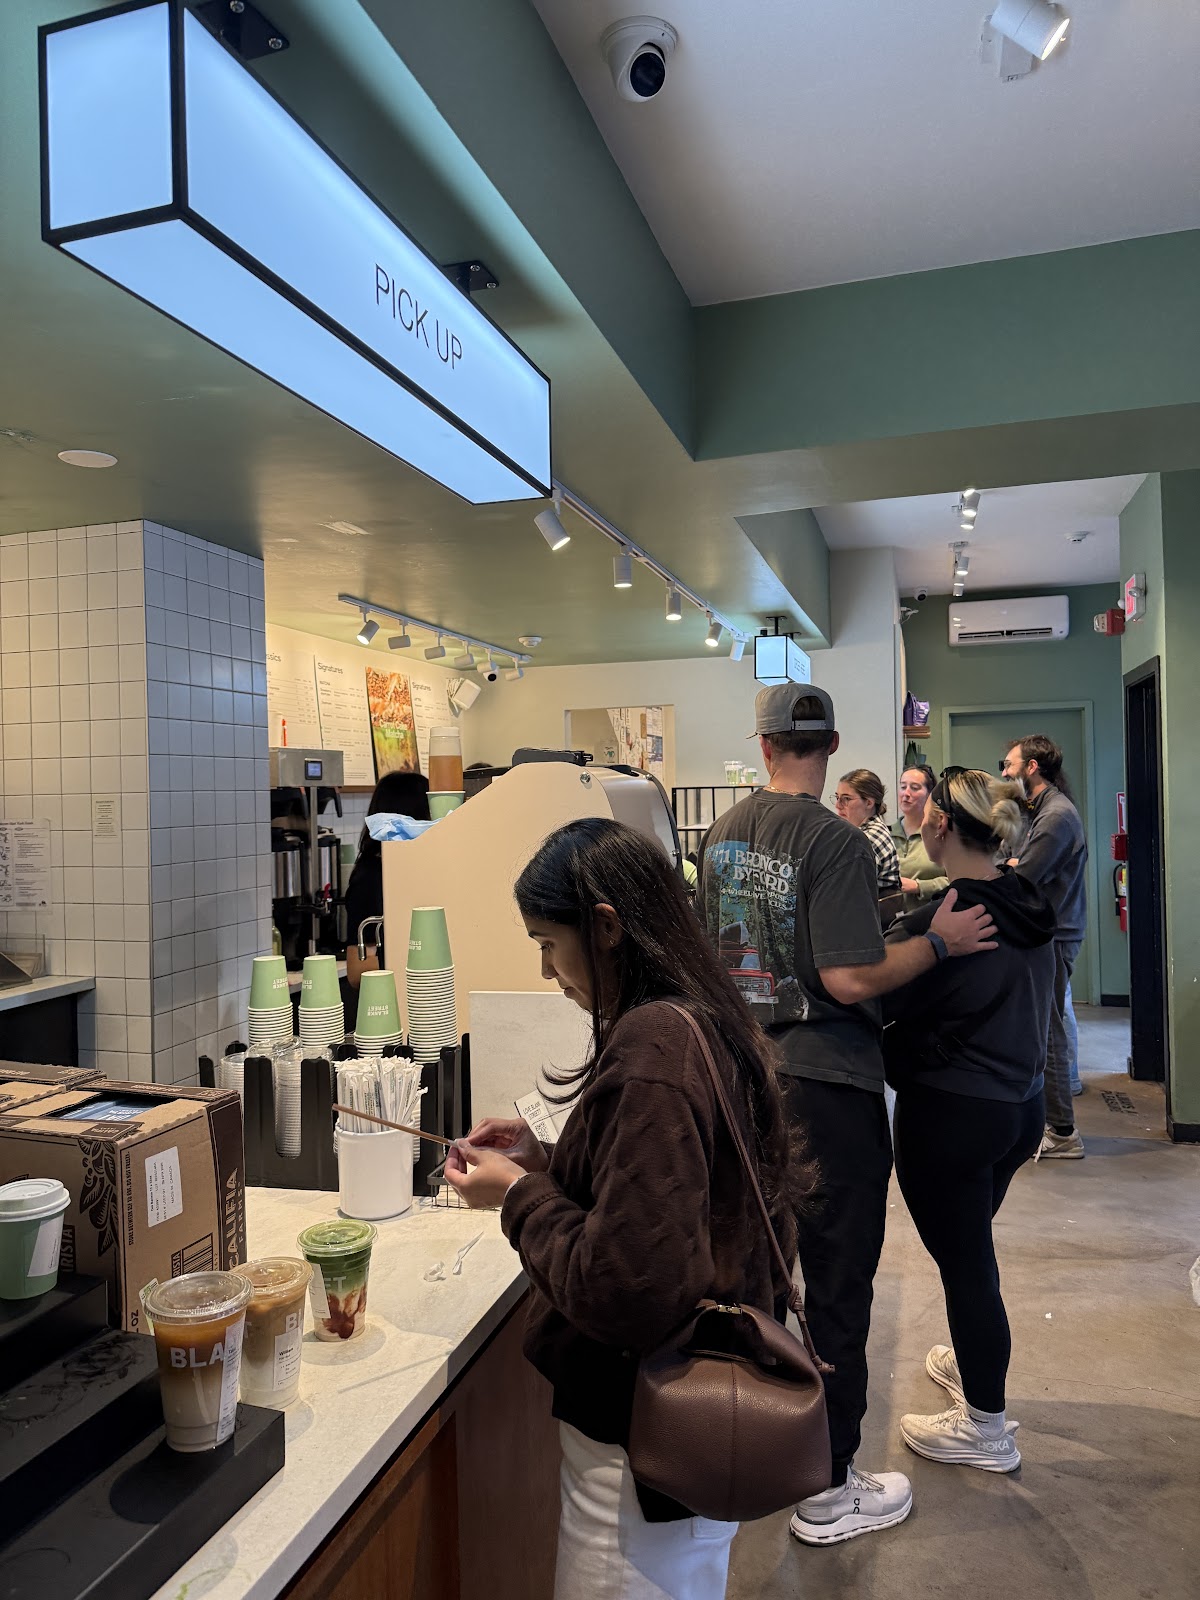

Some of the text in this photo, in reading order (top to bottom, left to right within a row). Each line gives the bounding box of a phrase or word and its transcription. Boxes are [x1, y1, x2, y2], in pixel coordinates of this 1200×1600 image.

[375, 263, 463, 370] PICK UP
[317, 662, 344, 674] Signatures
[735, 850, 793, 878] BRONCO
[226, 1167, 239, 1271] CALIFIA
[977, 1439, 1010, 1451] HOKA
